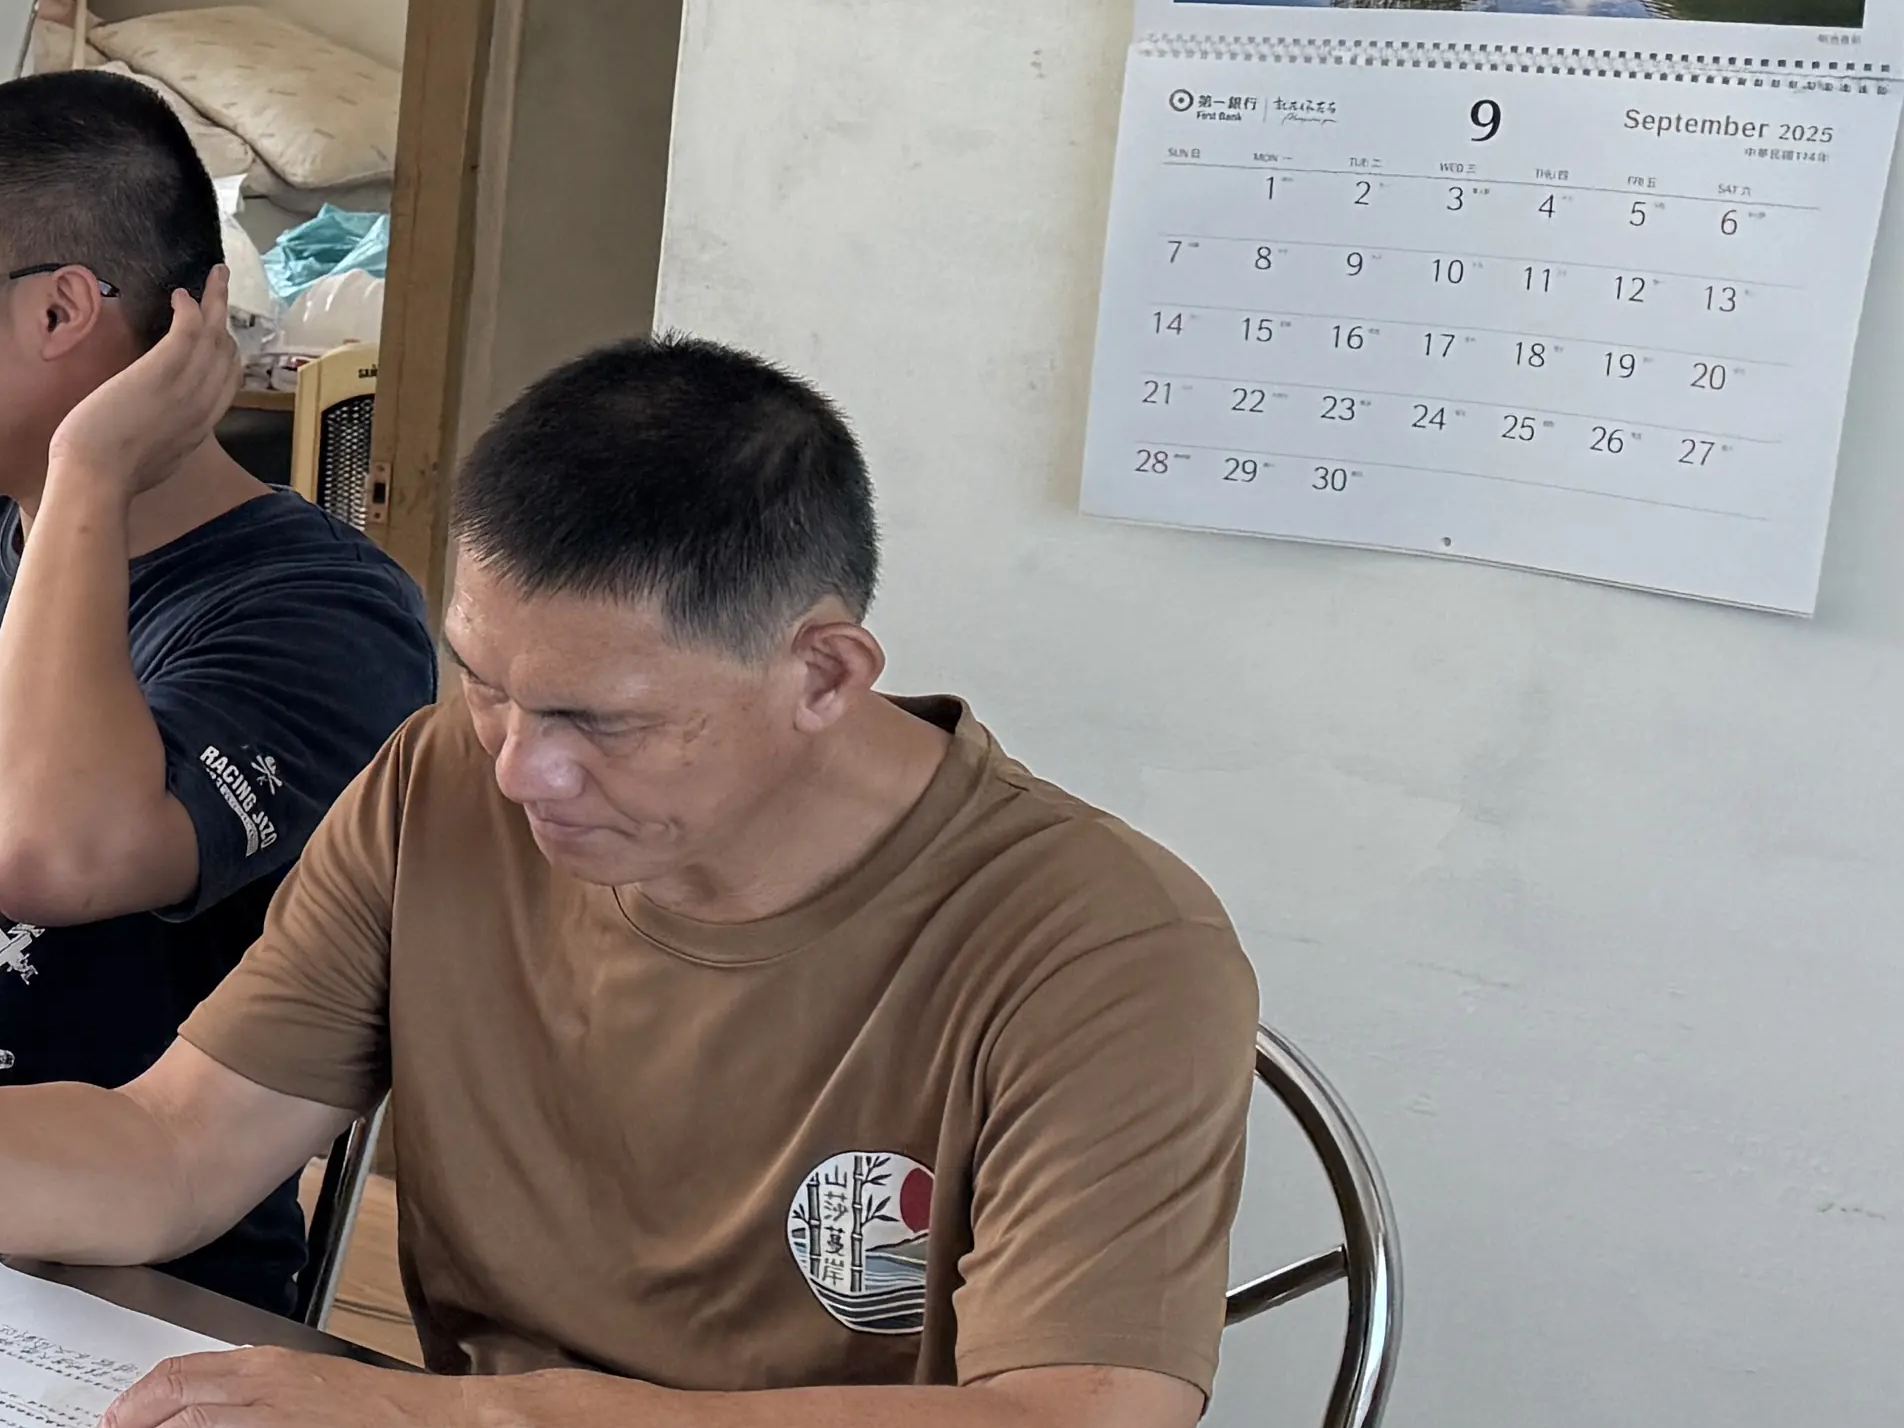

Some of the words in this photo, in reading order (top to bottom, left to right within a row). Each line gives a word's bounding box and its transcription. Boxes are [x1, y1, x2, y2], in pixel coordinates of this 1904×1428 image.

[1197, 94, 1257, 111] 第一銀行
[1470, 99, 1502, 142] 9
[1623, 108, 1769, 138] September
[1778, 123, 1834, 143] 2025
[1267, 176, 1274, 200] 1
[1353, 180, 1371, 206] 2
[1446, 186, 1464, 211] 3
[1538, 194, 1555, 219] 4
[1629, 201, 1646, 227] 5
[1720, 209, 1738, 236] 6
[1167, 240, 1183, 264] 7
[1254, 246, 1272, 270] 8
[1346, 251, 1363, 277] 9
[1433, 258, 1464, 284] 10
[1525, 266, 1551, 293] 11
[1615, 275, 1646, 303] 12
[1705, 285, 1736, 313] 13
[1153, 311, 1182, 335] 14
[1243, 317, 1273, 343] 15
[1333, 325, 1364, 350] 16
[1425, 332, 1456, 358] 17
[1516, 341, 1546, 368] 18
[1605, 351, 1636, 379] 19
[1690, 362, 1726, 391] 20
[1141, 379, 1171, 405] 21
[1231, 387, 1266, 413] 22
[1320, 395, 1355, 421] 23
[1411, 403, 1446, 431] 24
[1501, 414, 1536, 441] 25
[1589, 426, 1624, 454] 26
[1678, 438, 1716, 466] 27
[1134, 448, 1169, 474] 28
[1222, 457, 1258, 483] 29
[1311, 466, 1348, 492] 30
[199, 745, 258, 813] RACING
[252, 811, 279, 850] JIZO
